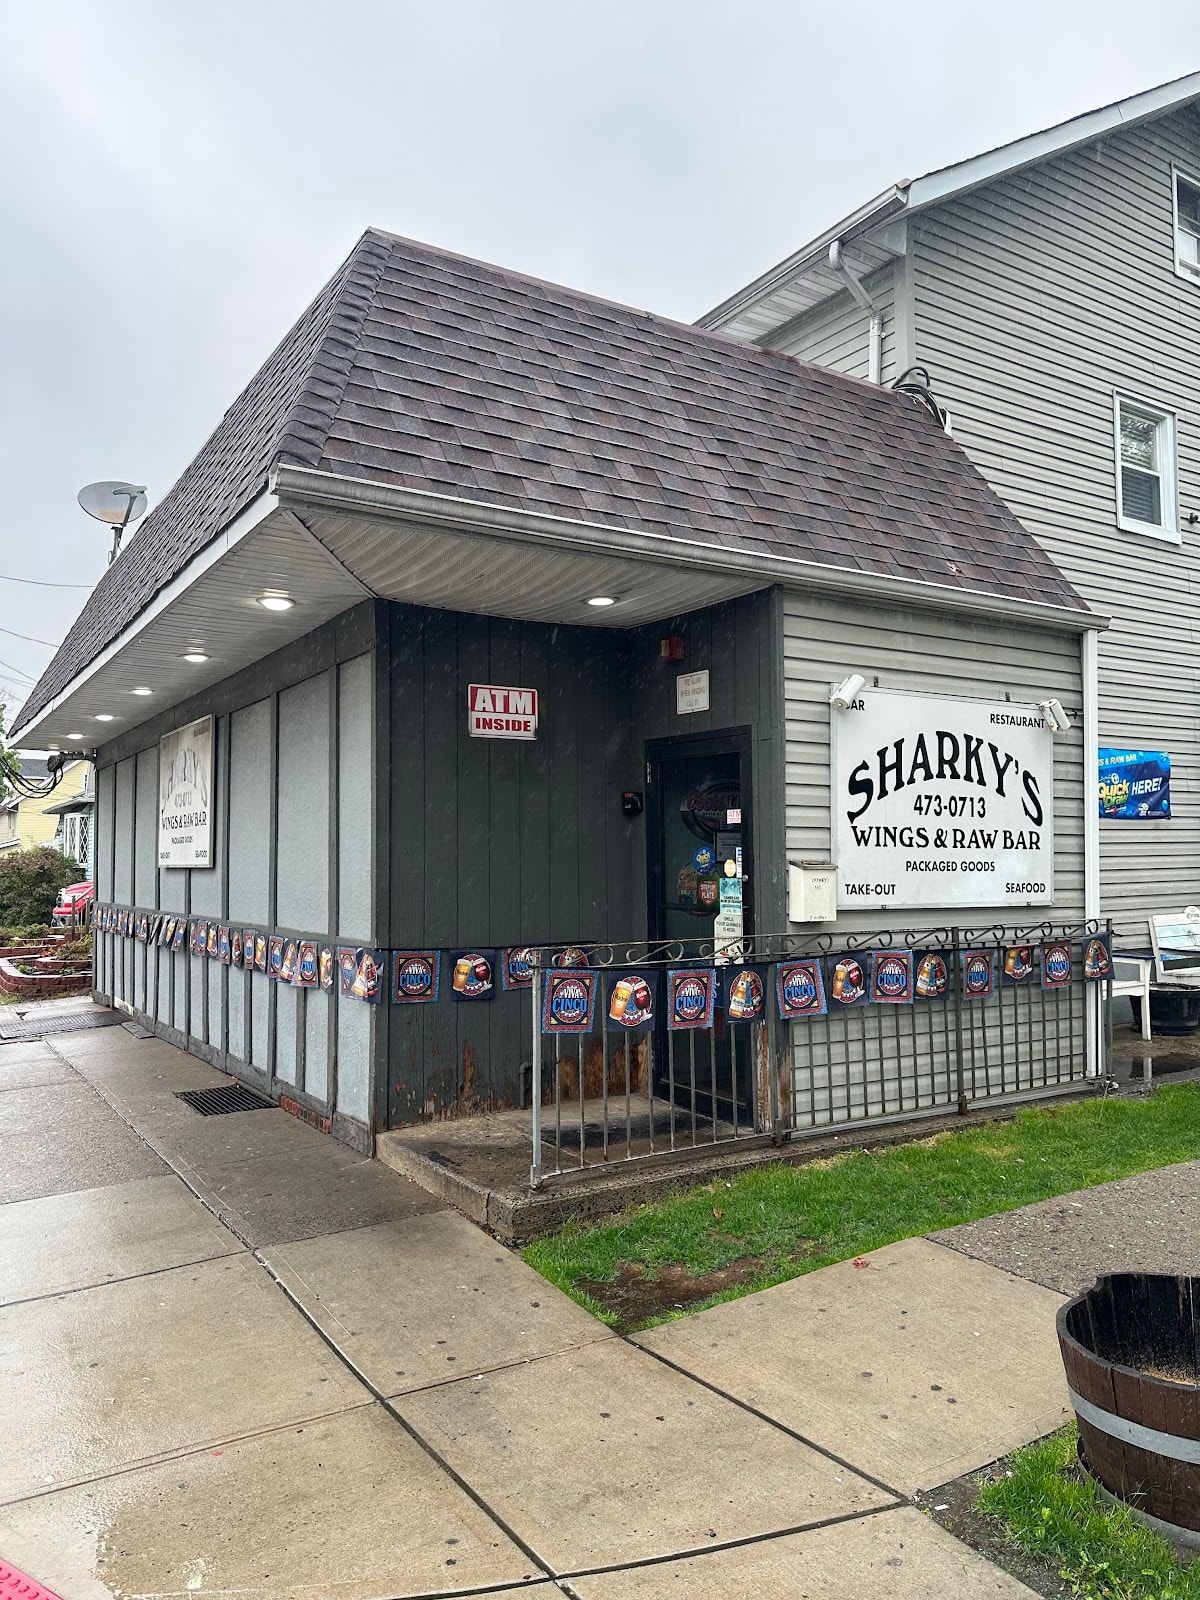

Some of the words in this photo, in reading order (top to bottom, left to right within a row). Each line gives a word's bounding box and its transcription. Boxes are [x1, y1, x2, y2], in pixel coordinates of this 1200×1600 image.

[474, 688, 533, 715] ATM
[846, 700, 865, 711] AR
[475, 717, 531, 732] INSIDE
[990, 713, 1045, 729] RESTAURANT
[1110, 755, 1125, 765] RAW
[1125, 753, 1137, 762] BAR
[847, 730, 1043, 827] SHARKY'S
[1131, 777, 1162, 796] HERE!
[913, 794, 986, 818] 473-0713
[851, 826, 930, 849] WINGS
[934, 829, 948, 849] &
[952, 828, 998, 849] RAW
[1002, 830, 1041, 850] BAR
[906, 860, 957, 872] PACKAGED
[960, 861, 995, 872] GOODS
[845, 883, 896, 895] TAKE-OUT
[1005, 882, 1046, 893] SEAFOOD
[1047, 961, 1070, 973] CINCO
[400, 974, 431, 987] CINCO
[877, 974, 907, 987] CINCO
[968, 971, 988, 982] CINCO
[563, 988, 580, 998] VIVA
[784, 984, 815, 1000] CINCO
[553, 998, 588, 1013] CINCO
[676, 995, 705, 1010] CINCO
